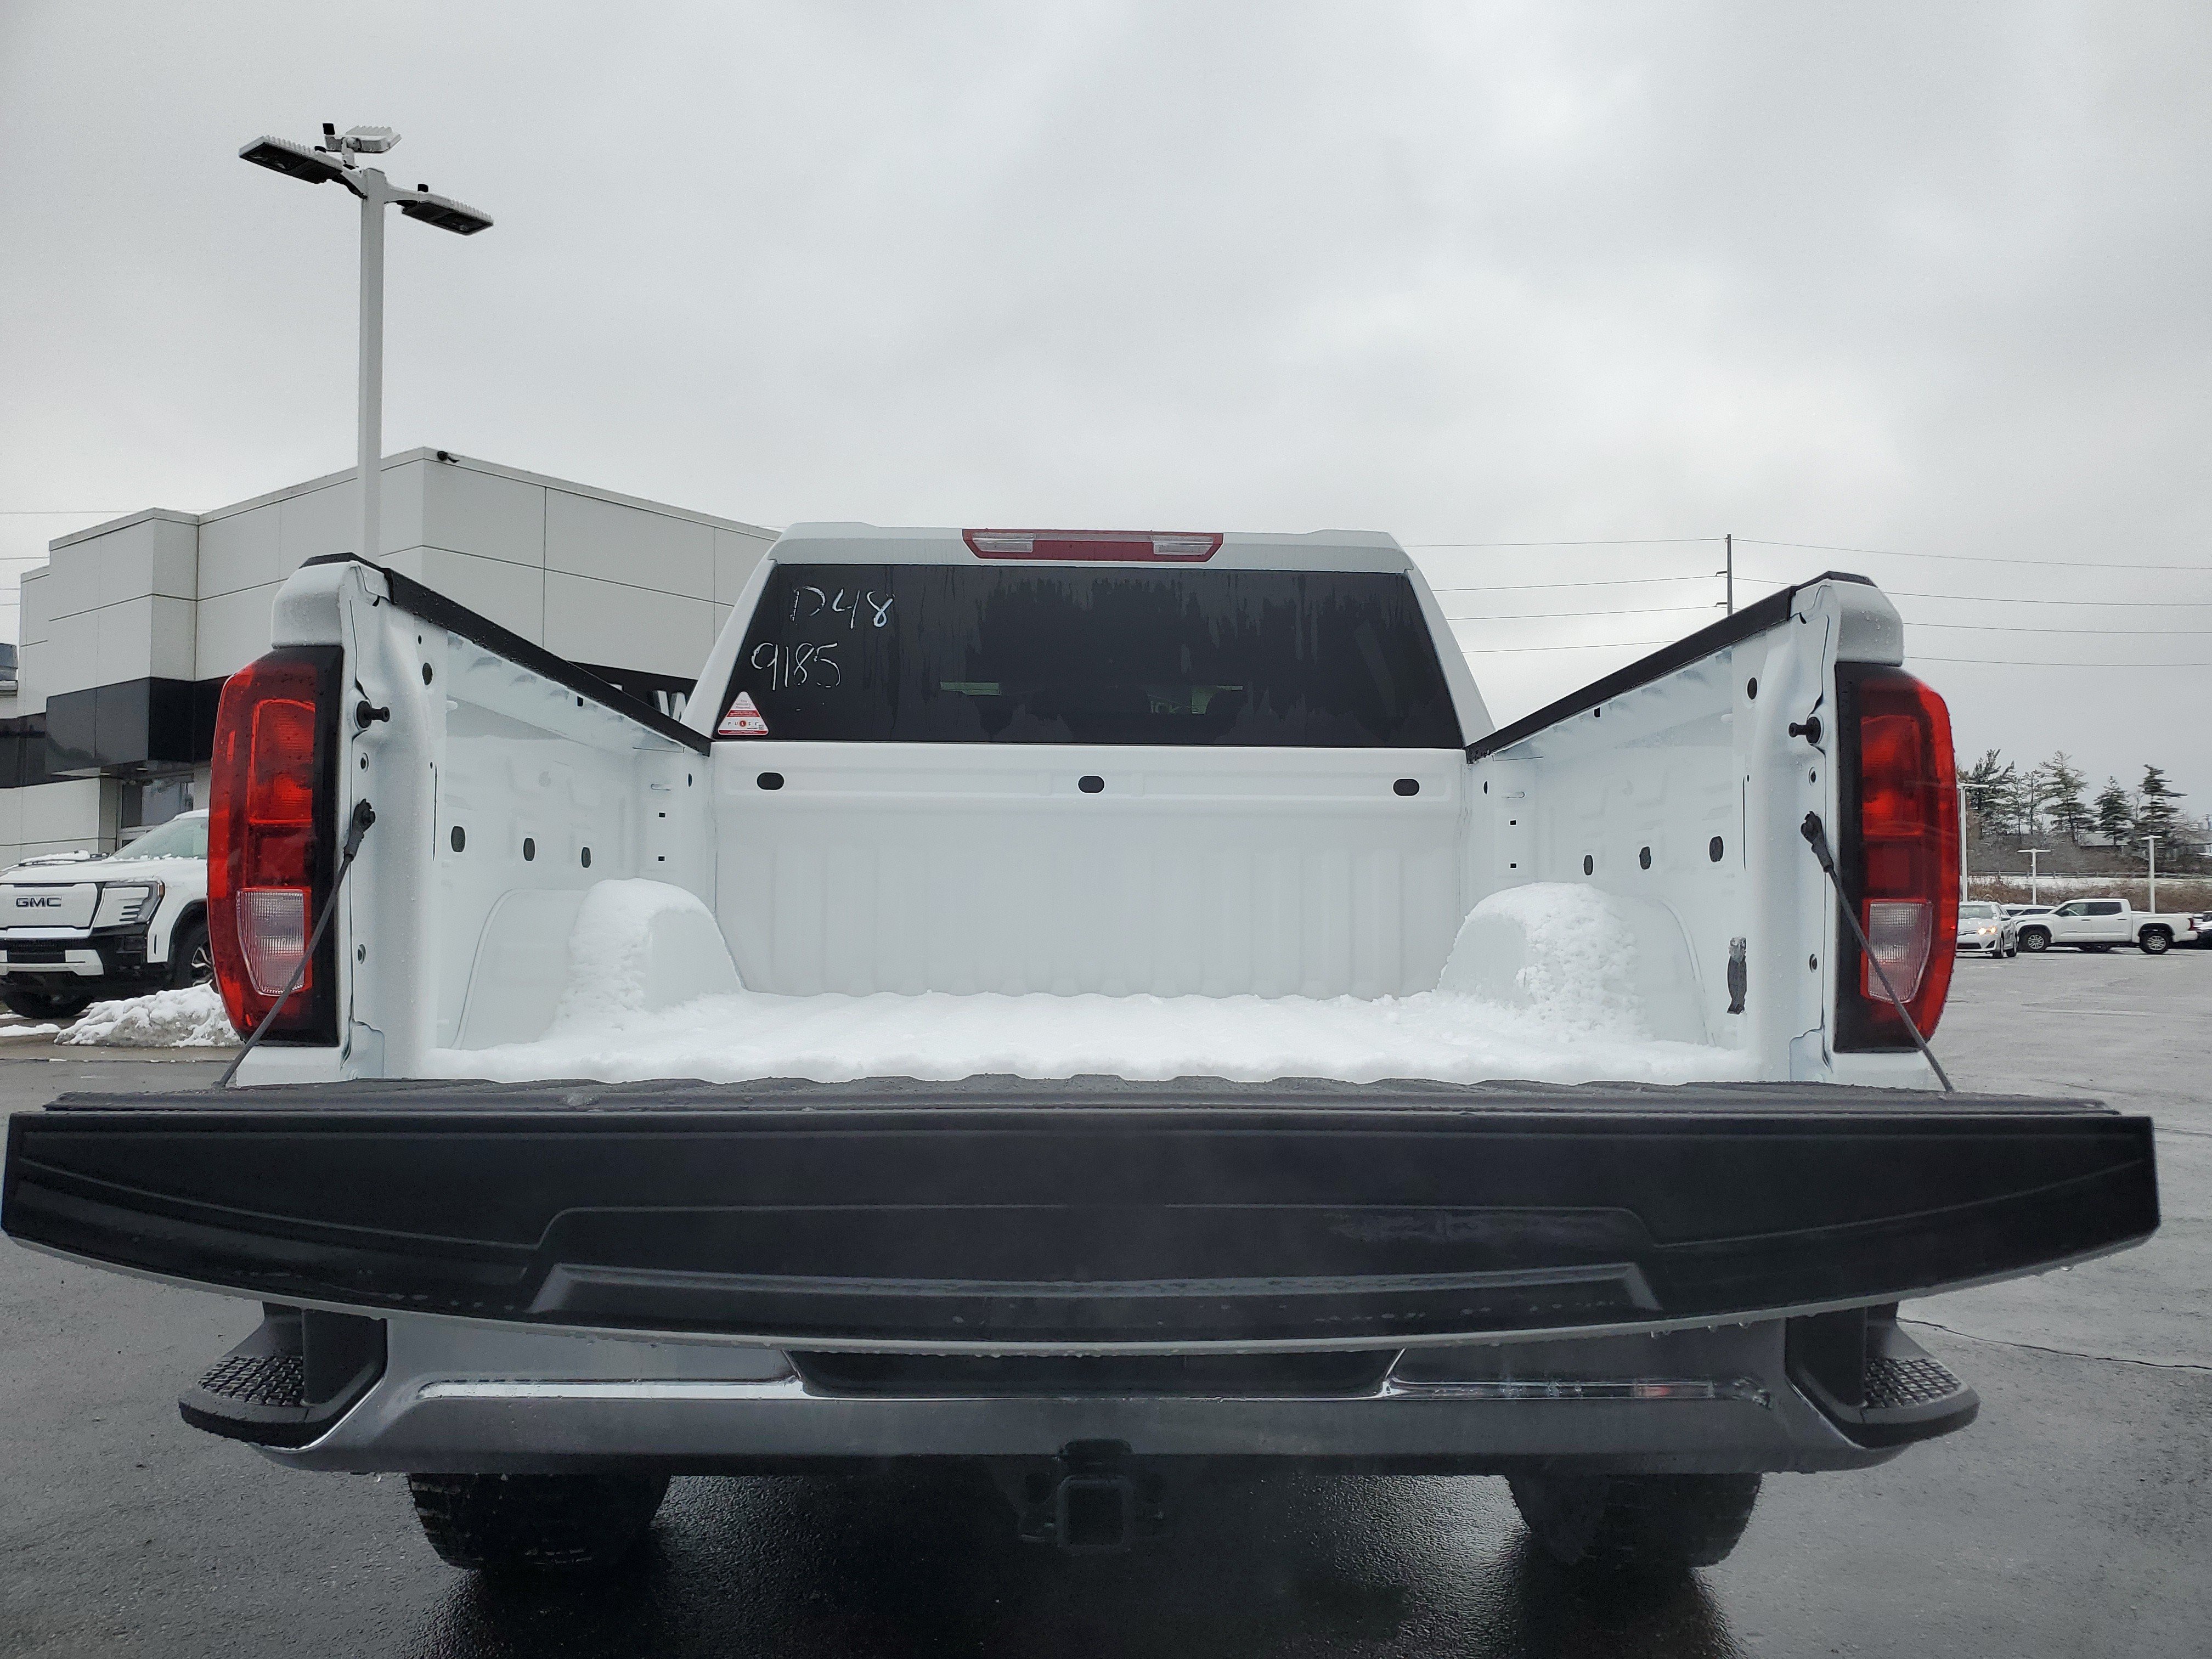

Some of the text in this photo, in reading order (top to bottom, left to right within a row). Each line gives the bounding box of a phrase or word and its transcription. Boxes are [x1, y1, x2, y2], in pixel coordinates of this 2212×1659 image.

[789, 585, 895, 629] D48
[751, 642, 841, 691] 9185
[16, 897, 61, 907] GMC
